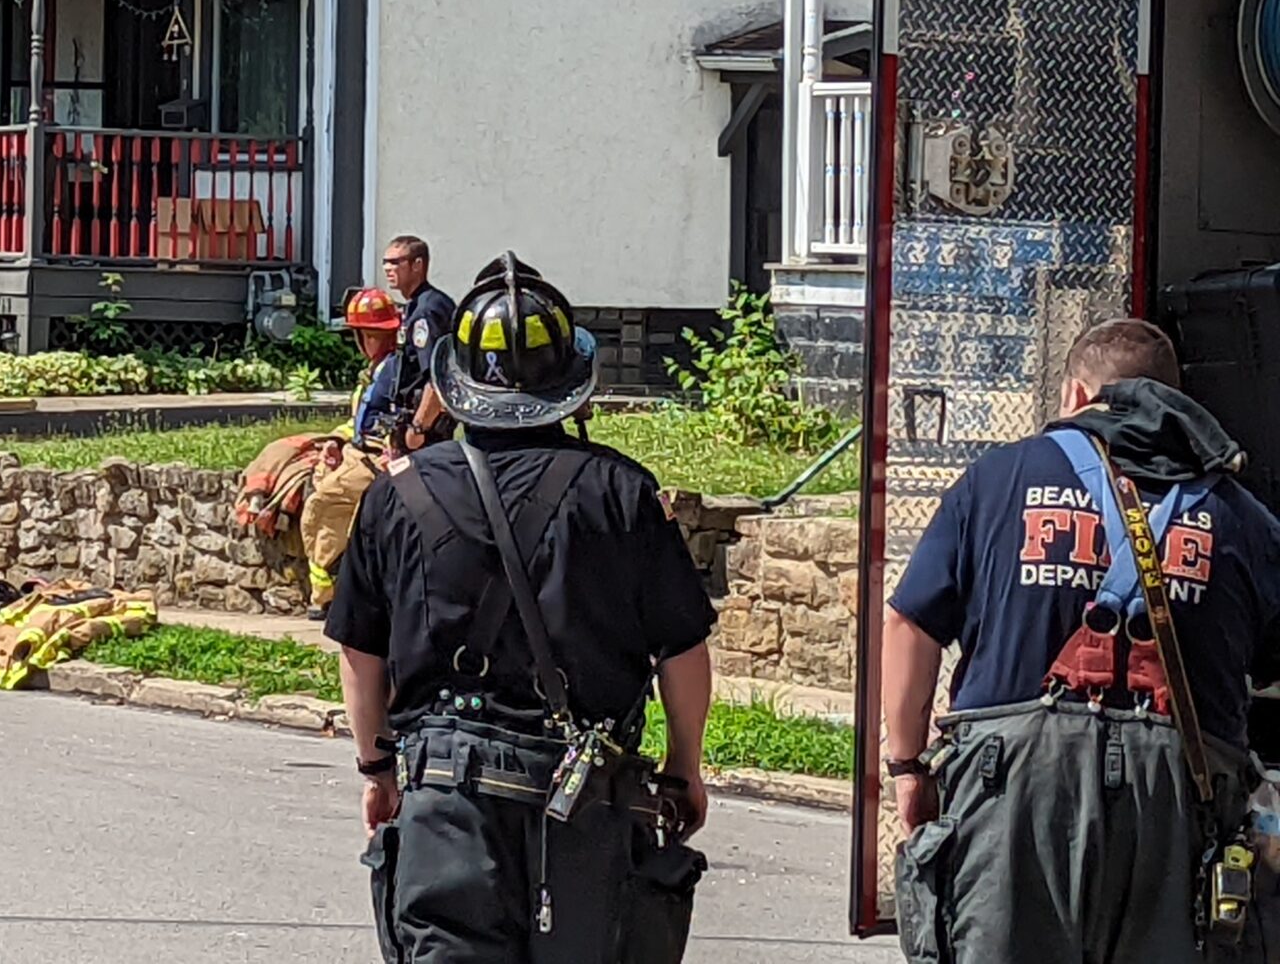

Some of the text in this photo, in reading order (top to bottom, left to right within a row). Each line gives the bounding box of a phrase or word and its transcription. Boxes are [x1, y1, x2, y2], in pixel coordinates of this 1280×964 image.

[1026, 486, 1099, 511] BEAV
[1020, 508, 1213, 582] FIE
[1125, 508, 1163, 588] STOWE
